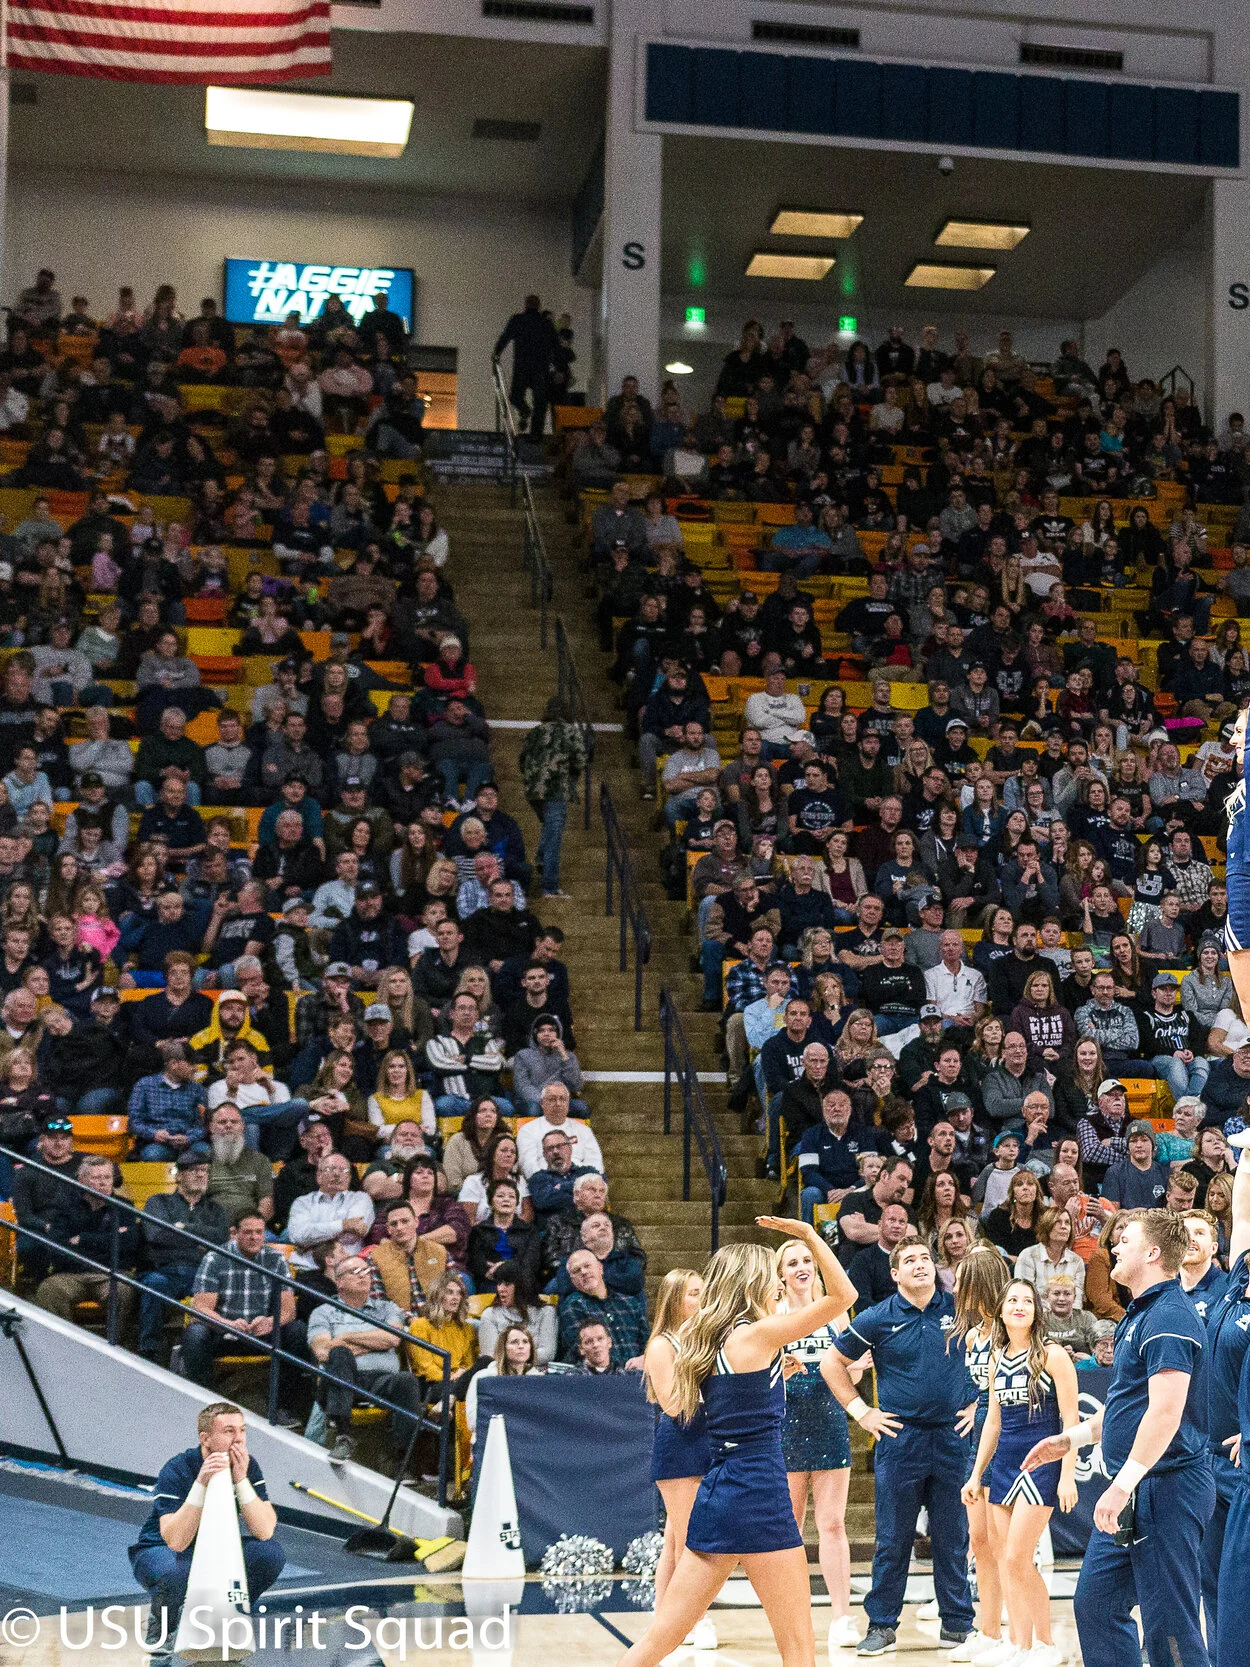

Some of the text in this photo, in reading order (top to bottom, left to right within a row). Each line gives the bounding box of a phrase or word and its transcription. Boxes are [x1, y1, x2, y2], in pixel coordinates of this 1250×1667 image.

[623, 243, 645, 270] S
[248, 262, 395, 297] #AGGIE
[1228, 283, 1249, 310] S
